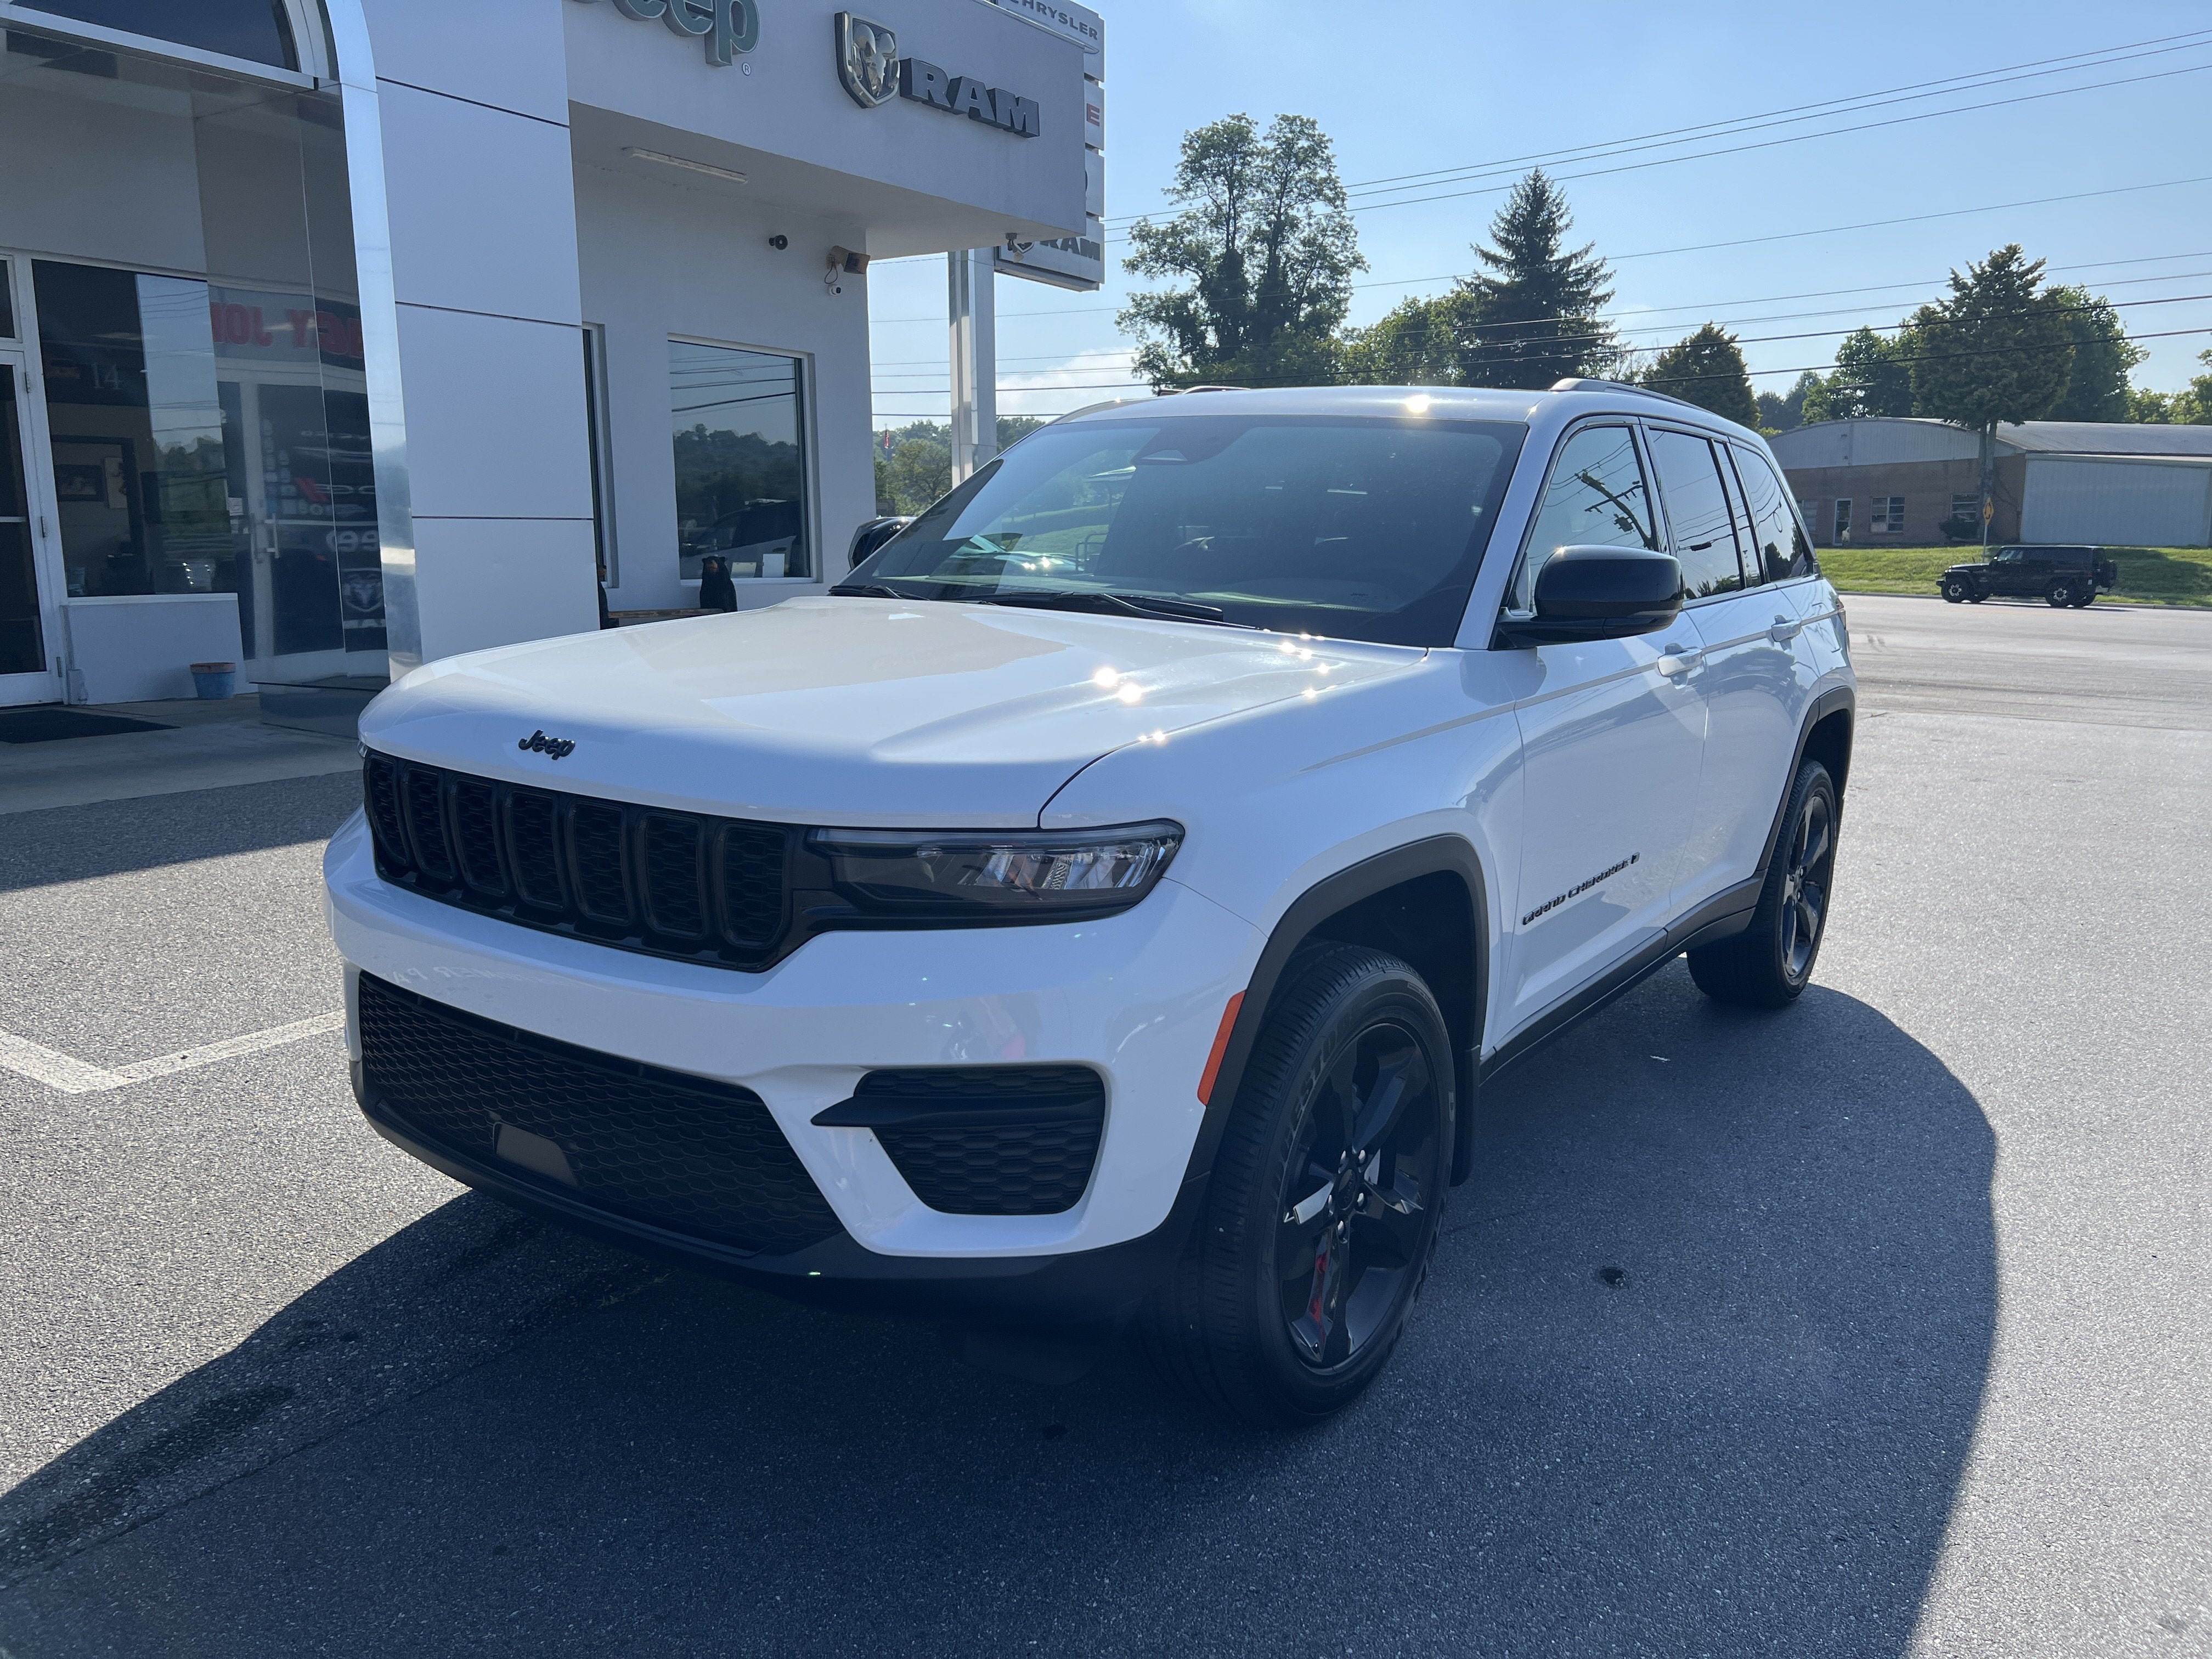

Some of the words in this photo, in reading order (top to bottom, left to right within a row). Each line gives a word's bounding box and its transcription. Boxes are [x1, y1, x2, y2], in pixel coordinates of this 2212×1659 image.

[900, 57, 1040, 138] RAM
[518, 729, 575, 761] Jeep
[1523, 893, 1566, 926] GRAND
[1568, 856, 1632, 898] CHEROKEE
